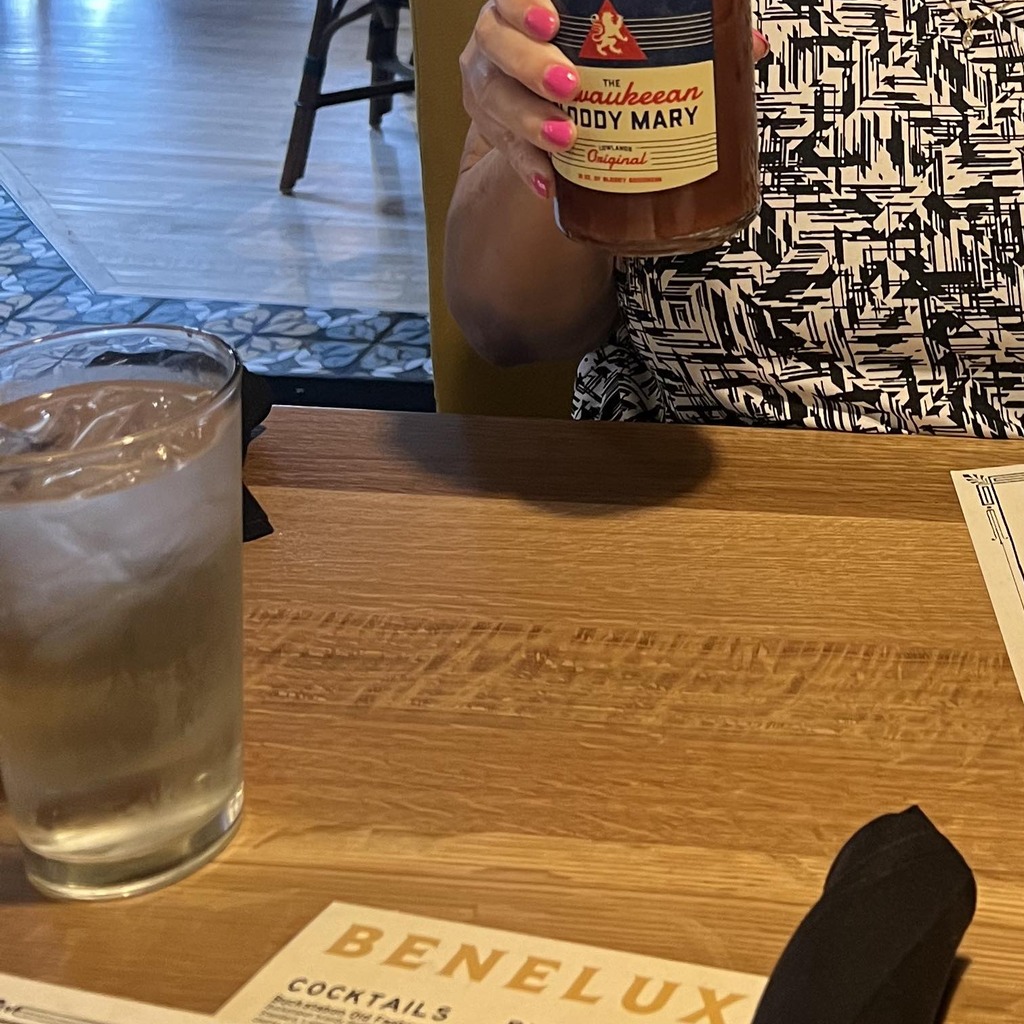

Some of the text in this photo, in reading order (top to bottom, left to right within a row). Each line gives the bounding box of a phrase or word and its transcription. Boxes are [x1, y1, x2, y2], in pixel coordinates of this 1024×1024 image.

[603, 78, 621, 88] THE
[631, 105, 698, 130] MARY
[587, 149, 648, 170] Original
[323, 923, 748, 1024] BENELUX
[288, 977, 452, 1022] COCKTAILS
